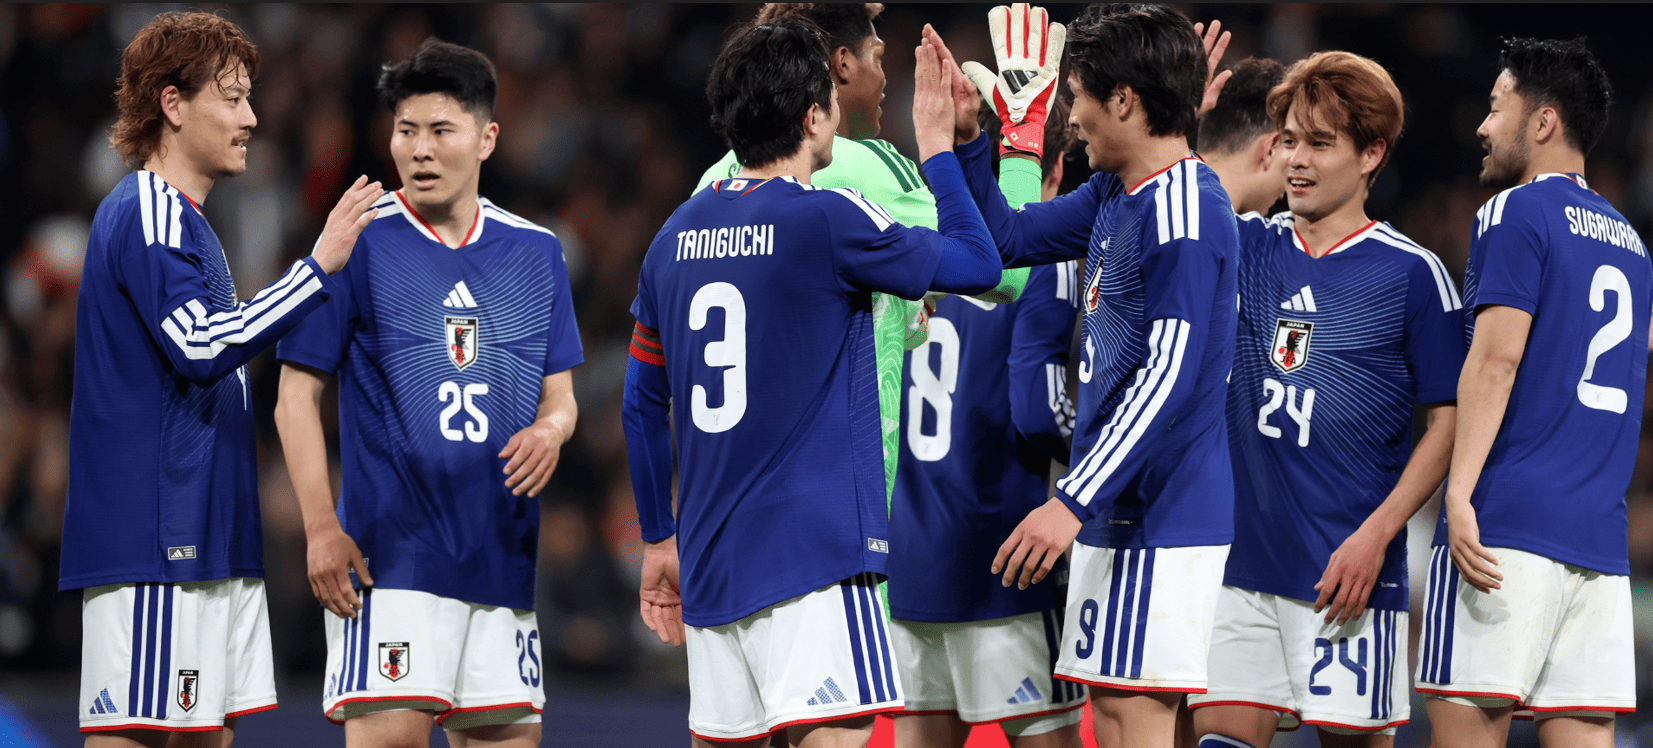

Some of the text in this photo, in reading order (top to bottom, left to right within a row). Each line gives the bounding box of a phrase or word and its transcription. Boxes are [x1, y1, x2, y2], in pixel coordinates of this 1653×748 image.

[676, 224, 774, 262] TANIGUCHI
[1565, 206, 1646, 258] SUGAWARA
[689, 281, 747, 433] 3
[1577, 264, 1633, 414] 2
[438, 381, 489, 443] 25
[907, 317, 960, 461] 8
[1258, 378, 1315, 447] 24
[516, 629, 540, 688] 25
[1075, 598, 1099, 660] 9
[1309, 637, 1368, 696] 24
